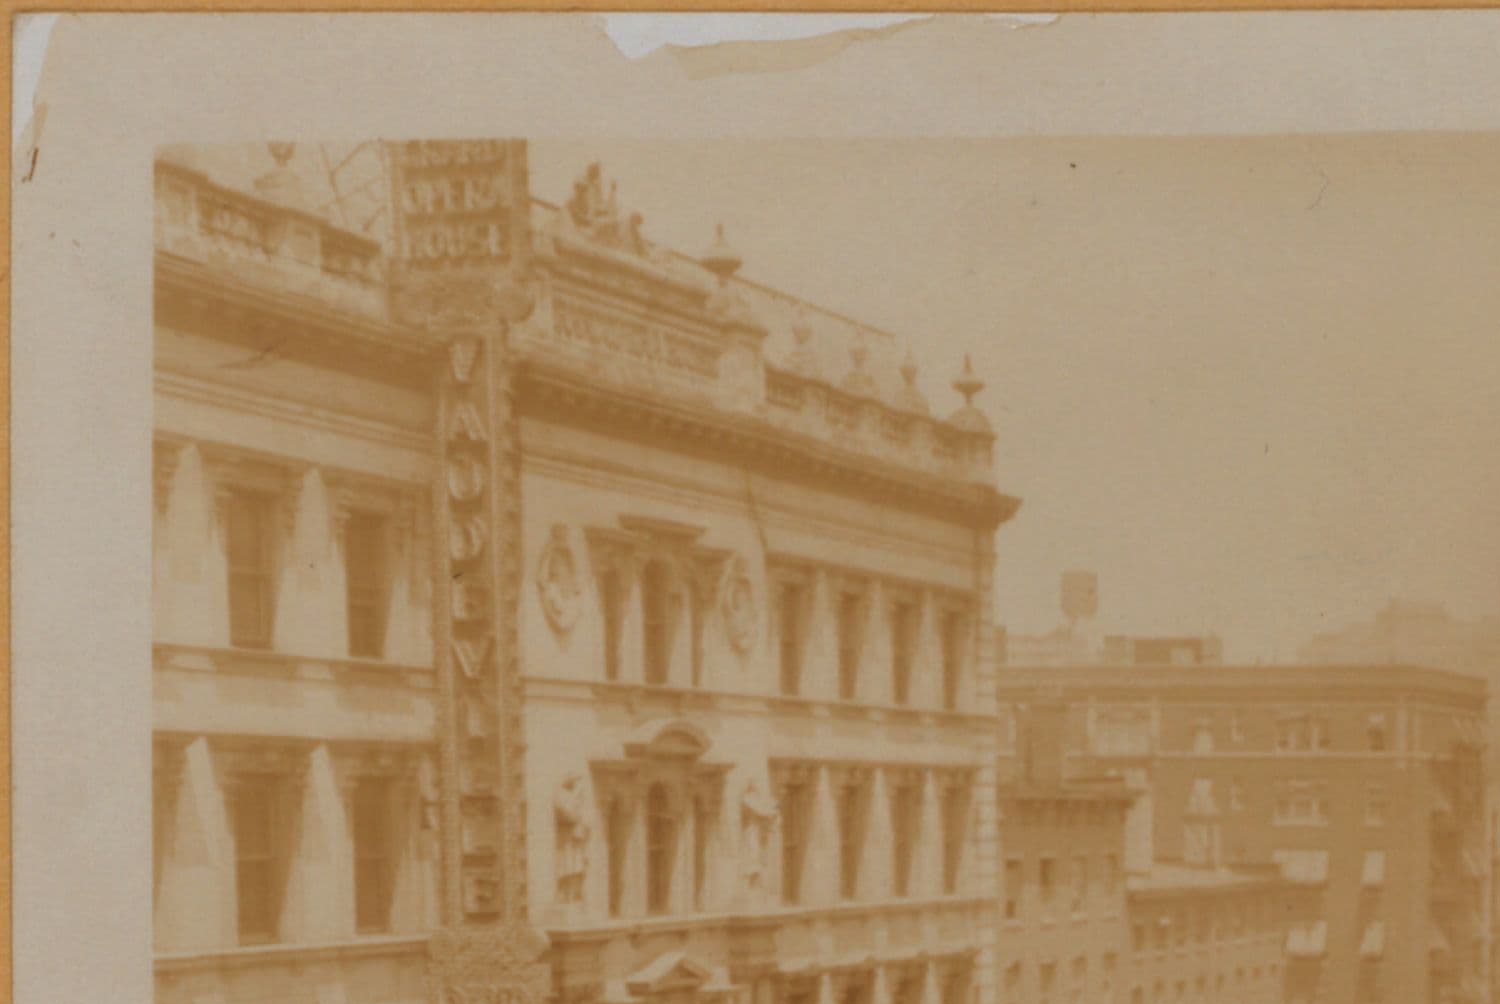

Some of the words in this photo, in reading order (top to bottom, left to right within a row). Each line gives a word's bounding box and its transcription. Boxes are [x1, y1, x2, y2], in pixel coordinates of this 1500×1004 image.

[402, 175, 510, 213] OPERA
[403, 223, 505, 259] HOUSE
[449, 341, 496, 912] VAUDEVILLE
